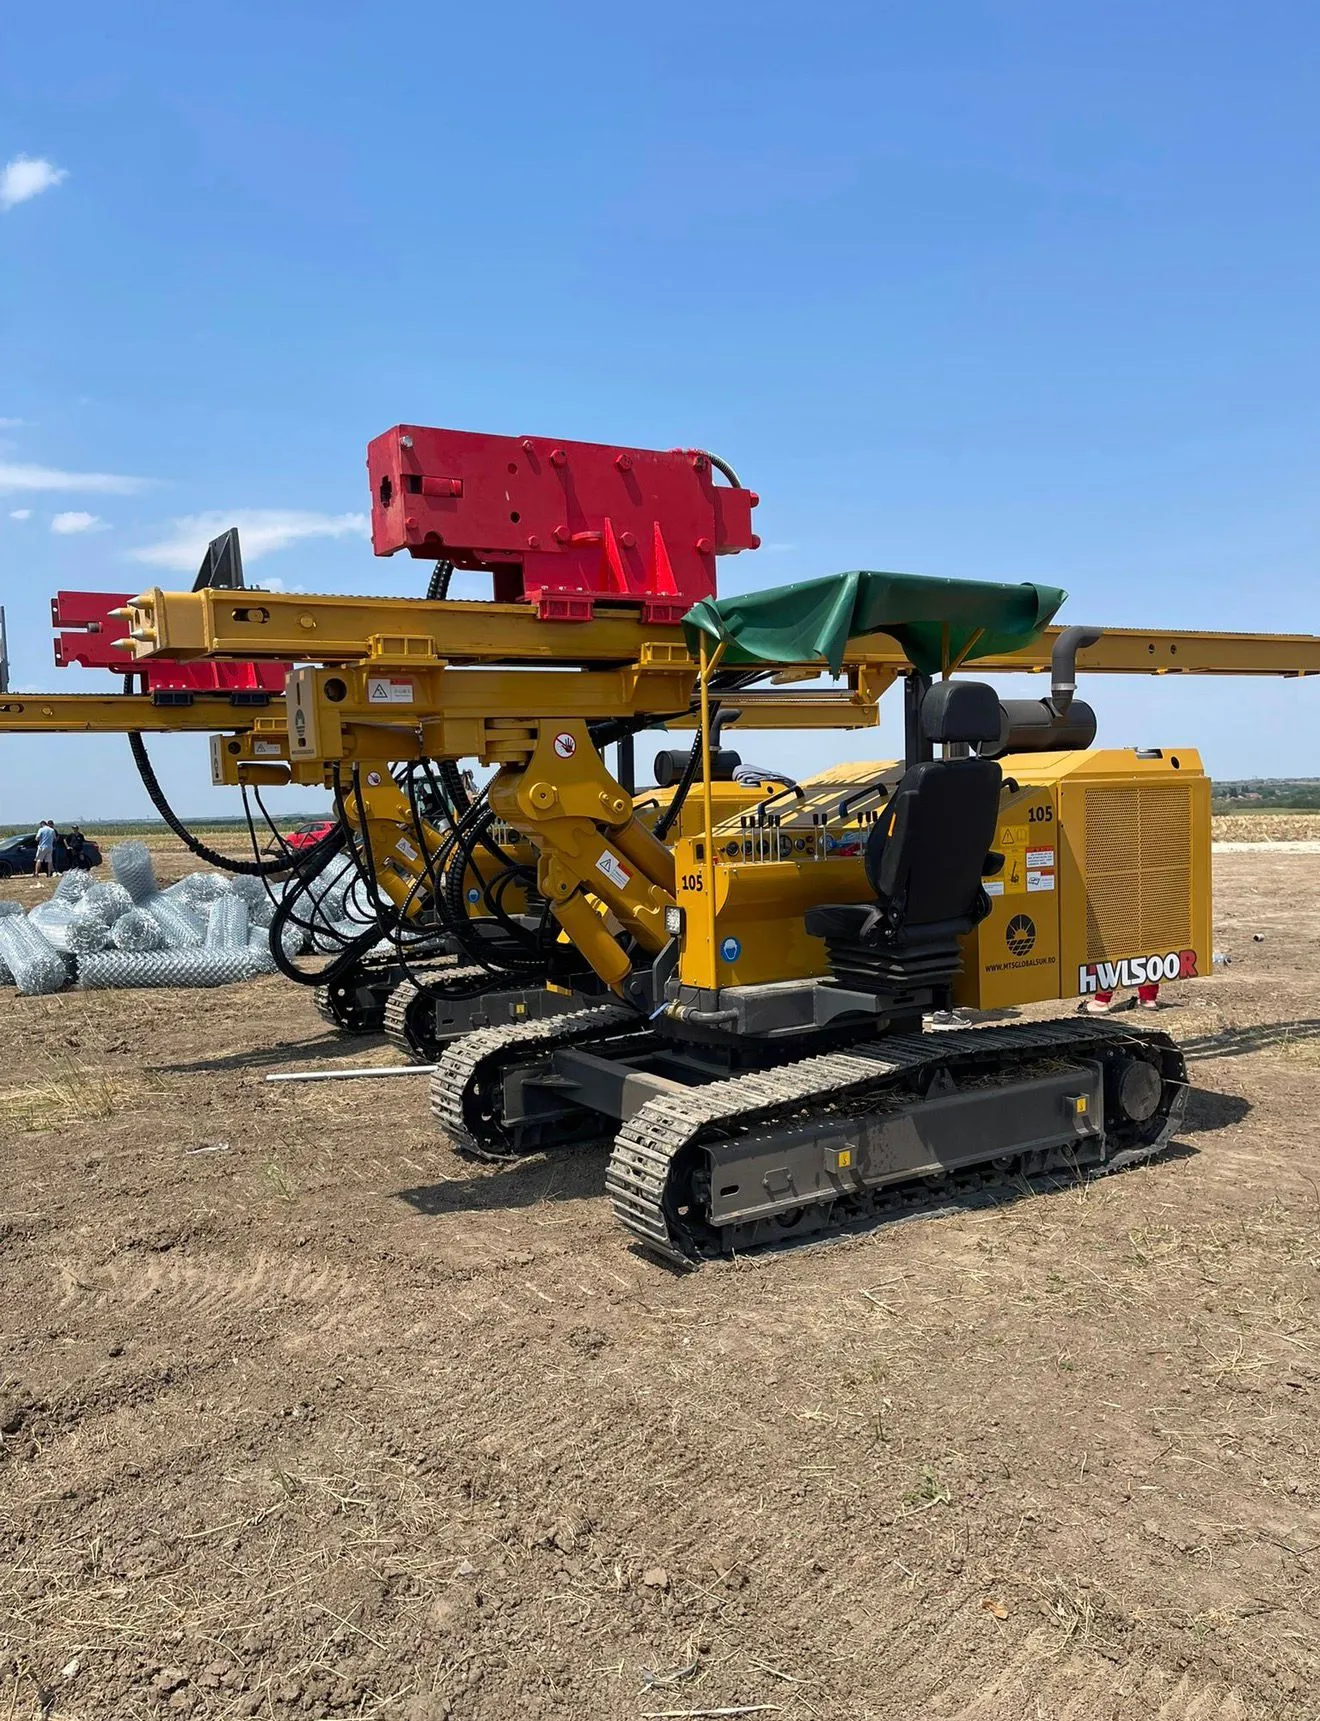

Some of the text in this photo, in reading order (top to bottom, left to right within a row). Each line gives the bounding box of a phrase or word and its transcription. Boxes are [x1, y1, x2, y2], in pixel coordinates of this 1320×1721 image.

[1028, 806, 1053, 822] 105
[682, 874, 703, 891] 105
[985, 956, 1056, 972] WWW.MTSGLOBALSUN.RO
[1079, 949, 1198, 994] HWL500R
